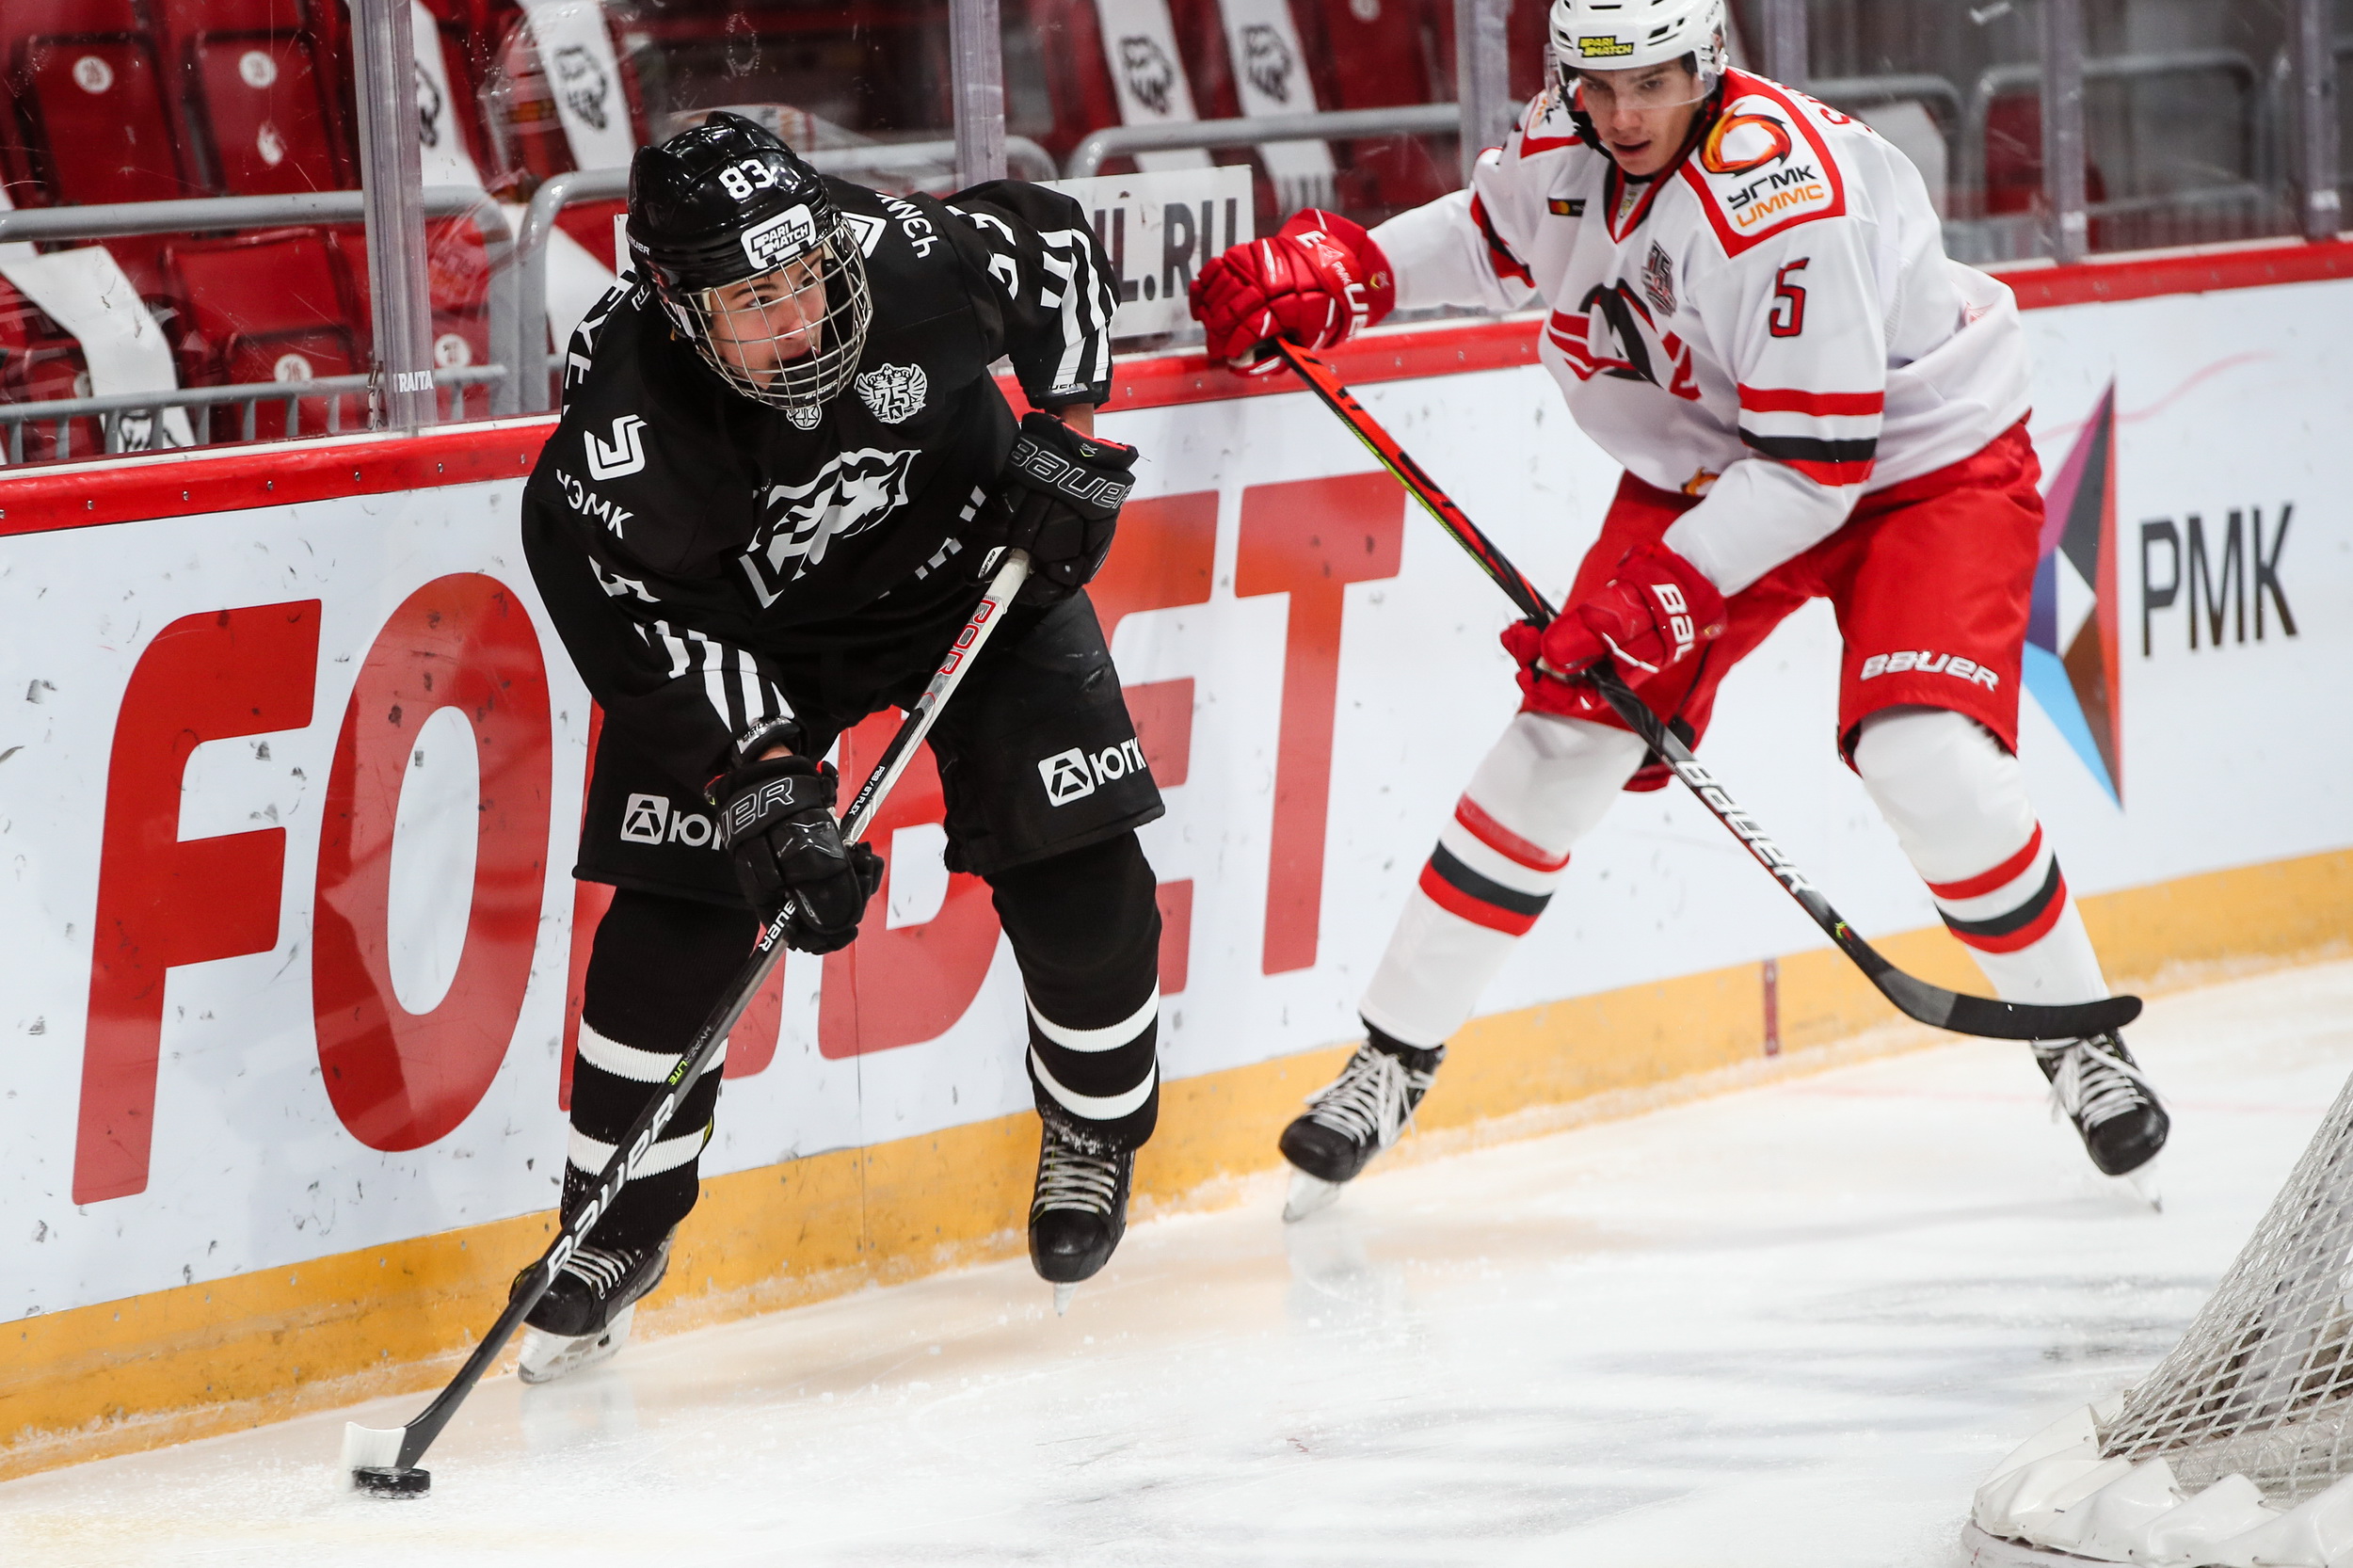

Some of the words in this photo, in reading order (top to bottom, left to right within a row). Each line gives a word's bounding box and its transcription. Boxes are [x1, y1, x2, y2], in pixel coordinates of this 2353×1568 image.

[717, 158, 776, 201] 83
[1726, 165, 1818, 211] УГМК
[1736, 184, 1826, 228] UMMC
[762, 224, 790, 246] PARI
[770, 224, 809, 253] MATCH
[1769, 256, 1811, 338] 5
[397, 369, 435, 393] RAITA
[873, 384, 913, 414] 75
[555, 468, 635, 540] ЧЭМК
[1860, 649, 2000, 694] BAUER
[1088, 736, 1147, 787] ЮГК
[849, 794, 865, 816] FLEX
[1674, 760, 1820, 895] BAUER
[72, 471, 1408, 1206] FOBET
[759, 899, 797, 952] AUER
